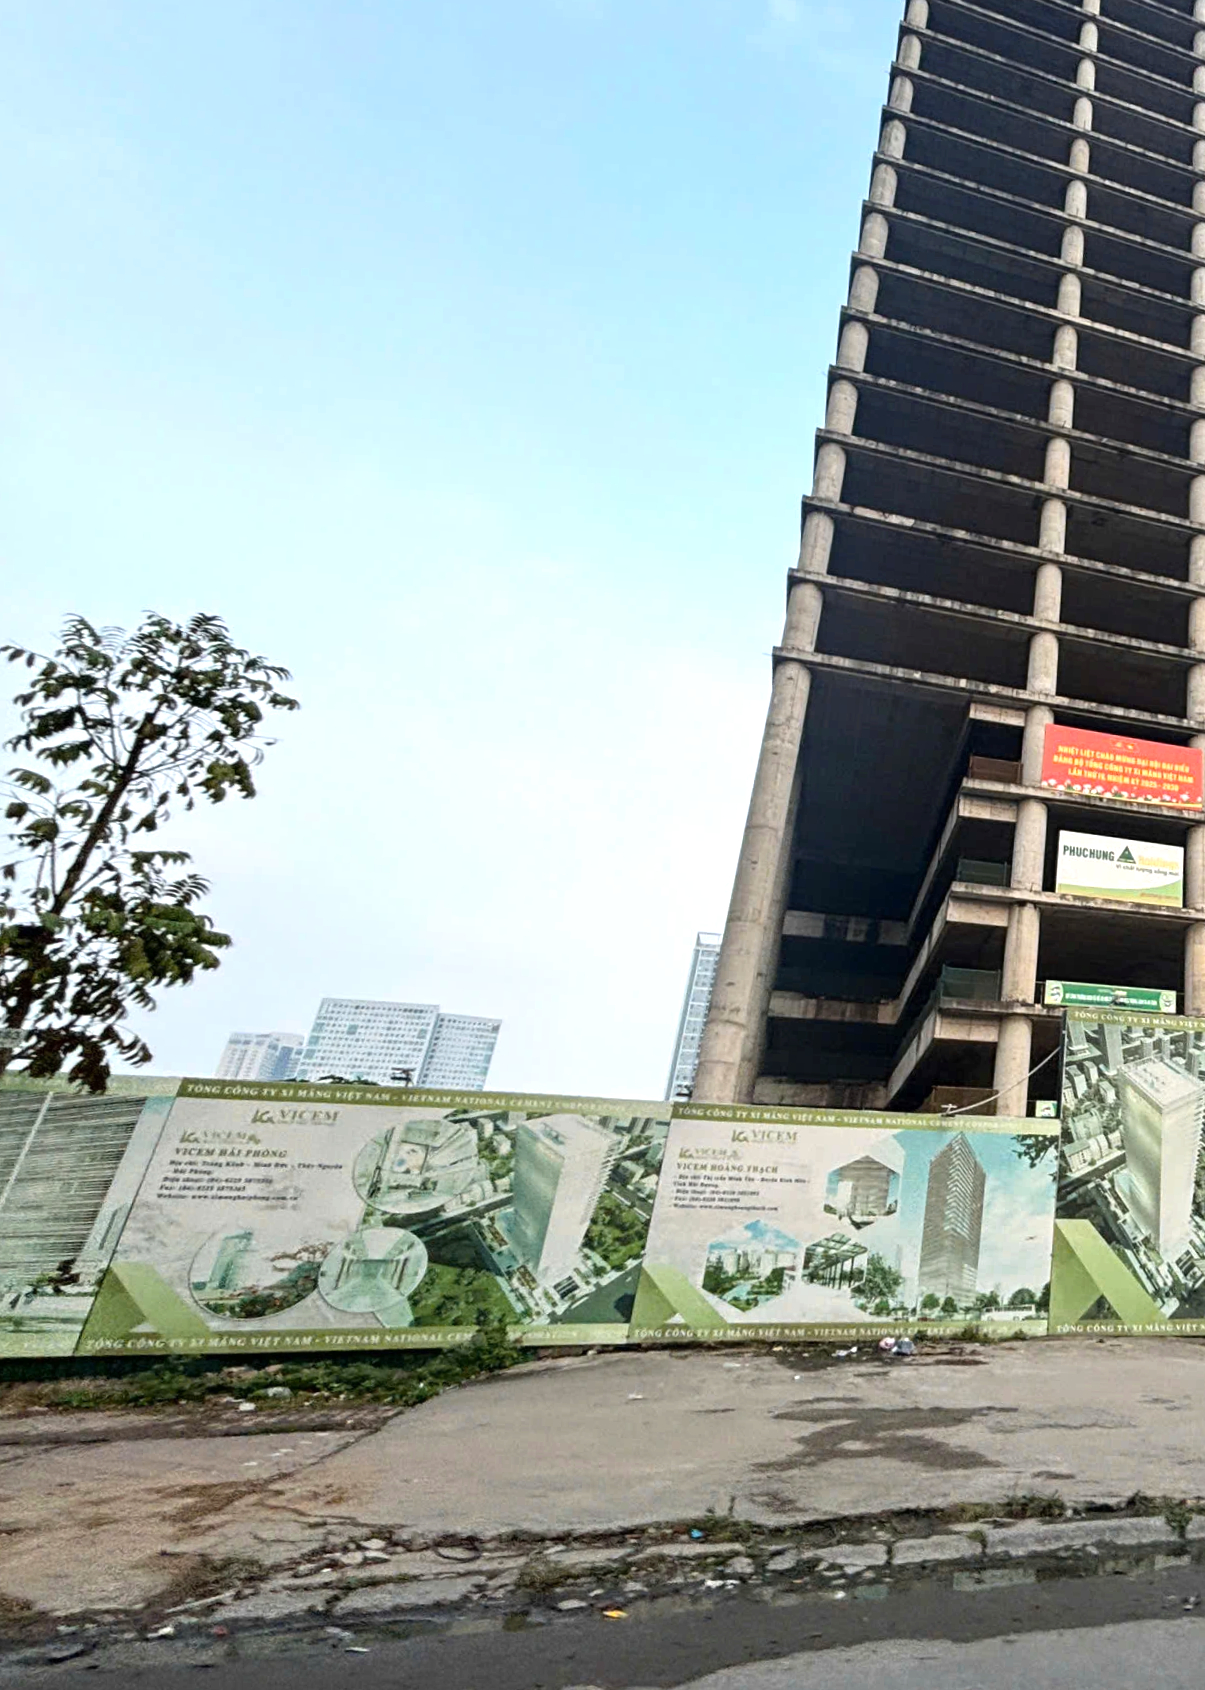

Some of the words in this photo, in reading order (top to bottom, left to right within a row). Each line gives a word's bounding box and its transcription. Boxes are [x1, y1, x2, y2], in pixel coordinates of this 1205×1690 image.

[1063, 844, 1115, 861] PHUCHUNG
[1100, 1012, 1126, 1023] CÔNG
[1179, 1019, 1198, 1029] VIỆT
[187, 1083, 221, 1094] TỔNG
[223, 1085, 258, 1096] CÔNG
[262, 1087, 278, 1097] TY
[298, 1087, 332, 1099] MĂNG
[335, 1090, 364, 1101] VIỆT
[365, 1092, 391, 1101] NAM
[401, 1094, 451, 1103] VIETNAM
[454, 1096, 506, 1106] NATIONAL
[280, 1109, 340, 1121] VICEM
[678, 1106, 704, 1116] TỔNG
[706, 1108, 733, 1118] CÔNG
[763, 1111, 790, 1121] MĂNG
[792, 1113, 813, 1122] VIỆT
[816, 1114, 835, 1123] NAM
[844, 1116, 883, 1124] VIETNAM
[885, 1117, 928, 1127] NATIONAL
[752, 1129, 798, 1141] VICEM
[175, 1147, 216, 1156] VICEM
[244, 1149, 287, 1158] PHÒNG
[677, 1162, 708, 1171] VICEM
[710, 1163, 744, 1172] HOÀNG
[665, 1327, 693, 1338] CÔNG
[696, 1329, 709, 1337] TY
[727, 1326, 755, 1337] MĂNG
[758, 1327, 780, 1338] VIỆT
[784, 1328, 805, 1337] NAM
[814, 1328, 856, 1336] VIETNAM
[859, 1327, 905, 1337] NATIONAL
[1086, 1323, 1114, 1333] CÔNG
[1117, 1324, 1128, 1332] TY
[1145, 1322, 1173, 1332] MĂNG
[1175, 1322, 1199, 1333] VIỆT
[127, 1337, 165, 1349] CÔNG
[169, 1338, 184, 1348] TY
[209, 1335, 245, 1347] MĂNG
[250, 1336, 281, 1347] VIỆT
[283, 1336, 313, 1346] NAM
[325, 1334, 380, 1345] VIETNAM
[383, 1333, 444, 1344] NATIONAL
